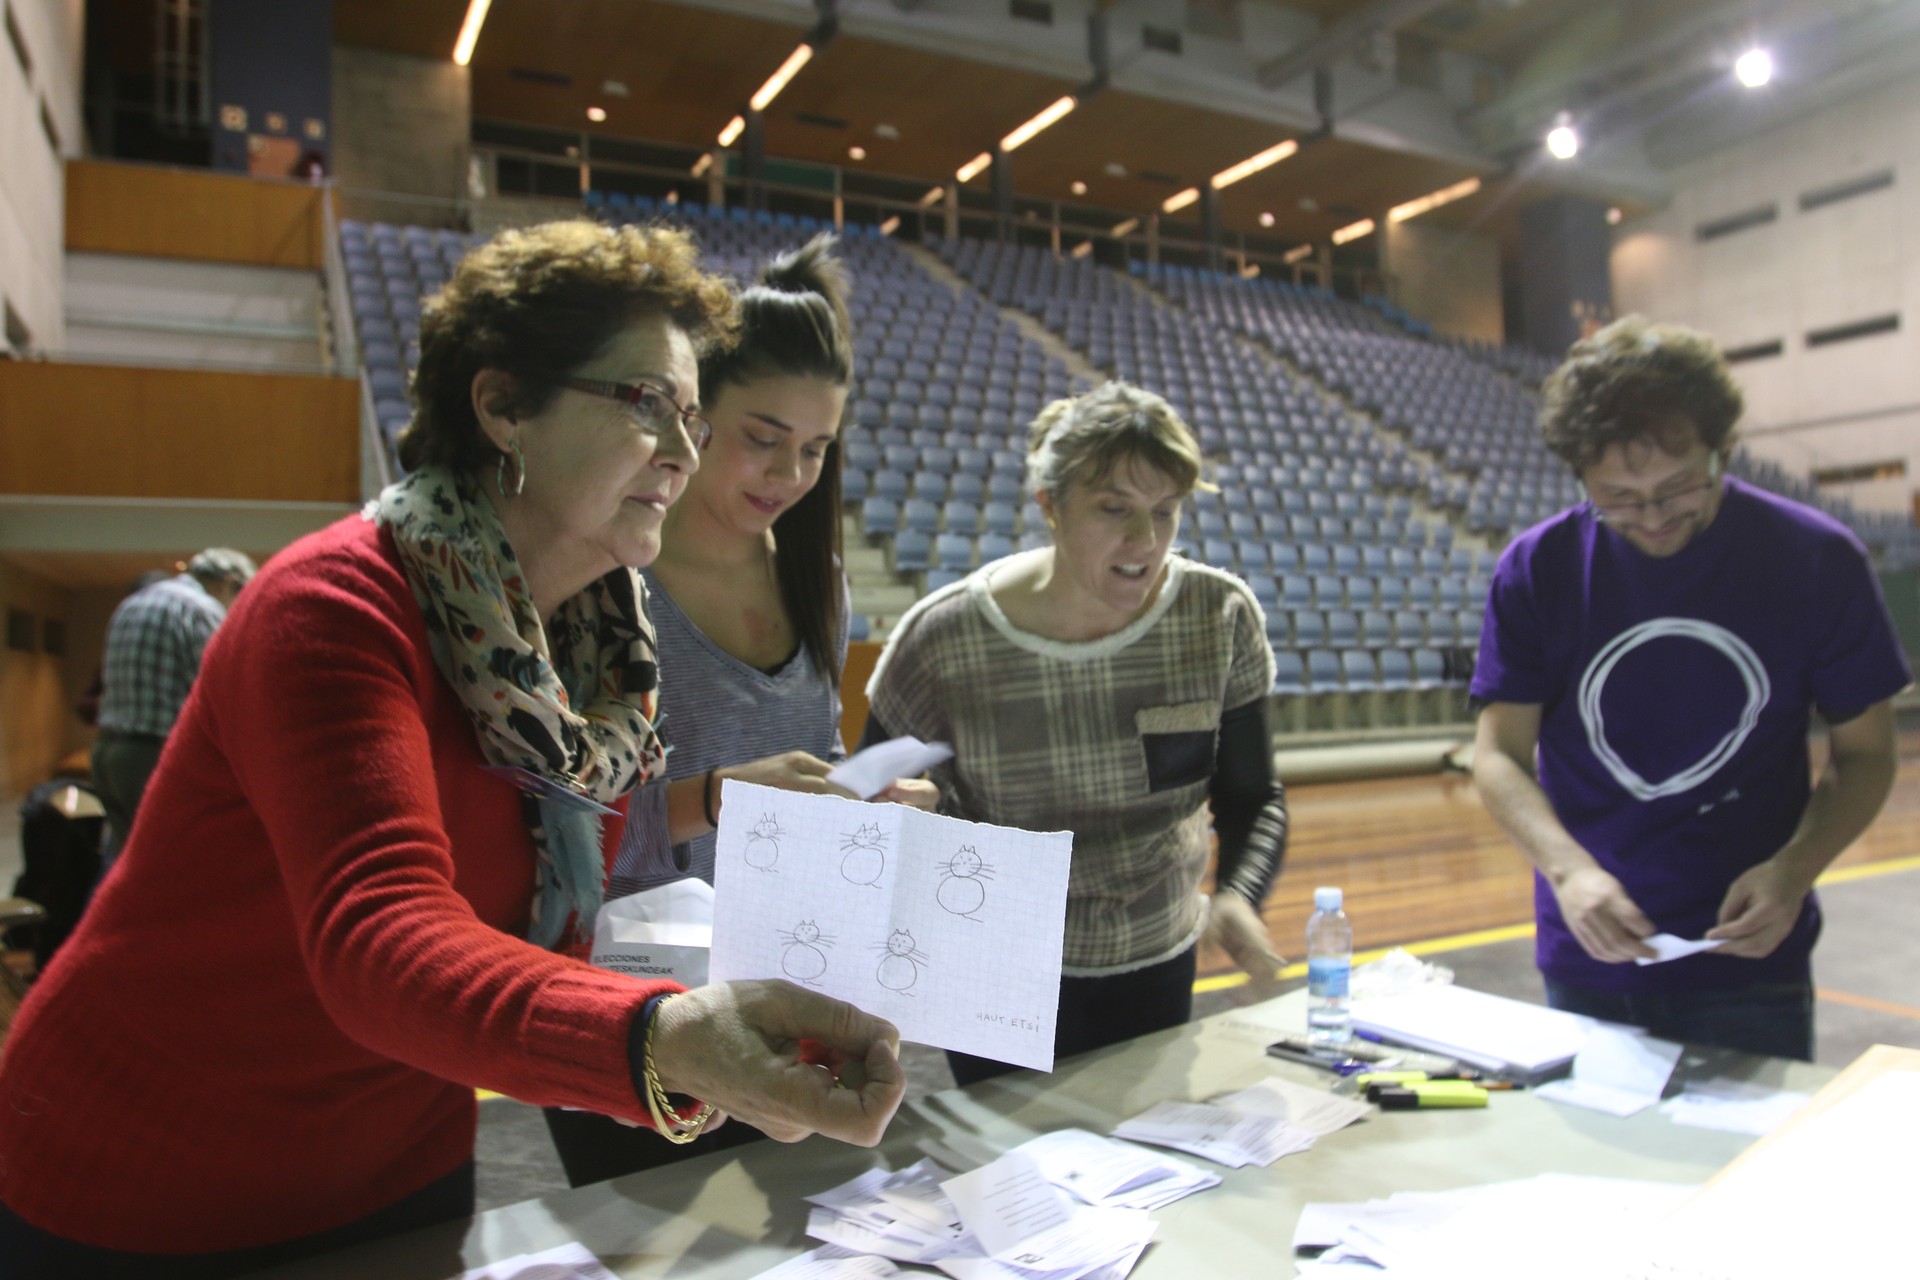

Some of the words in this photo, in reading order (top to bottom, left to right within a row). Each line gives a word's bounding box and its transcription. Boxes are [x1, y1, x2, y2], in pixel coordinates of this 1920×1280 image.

[594, 954, 650, 963] ELECCIONES
[606, 965, 674, 975] TESKUNDEAK
[977, 1013, 1005, 1024] HAUT
